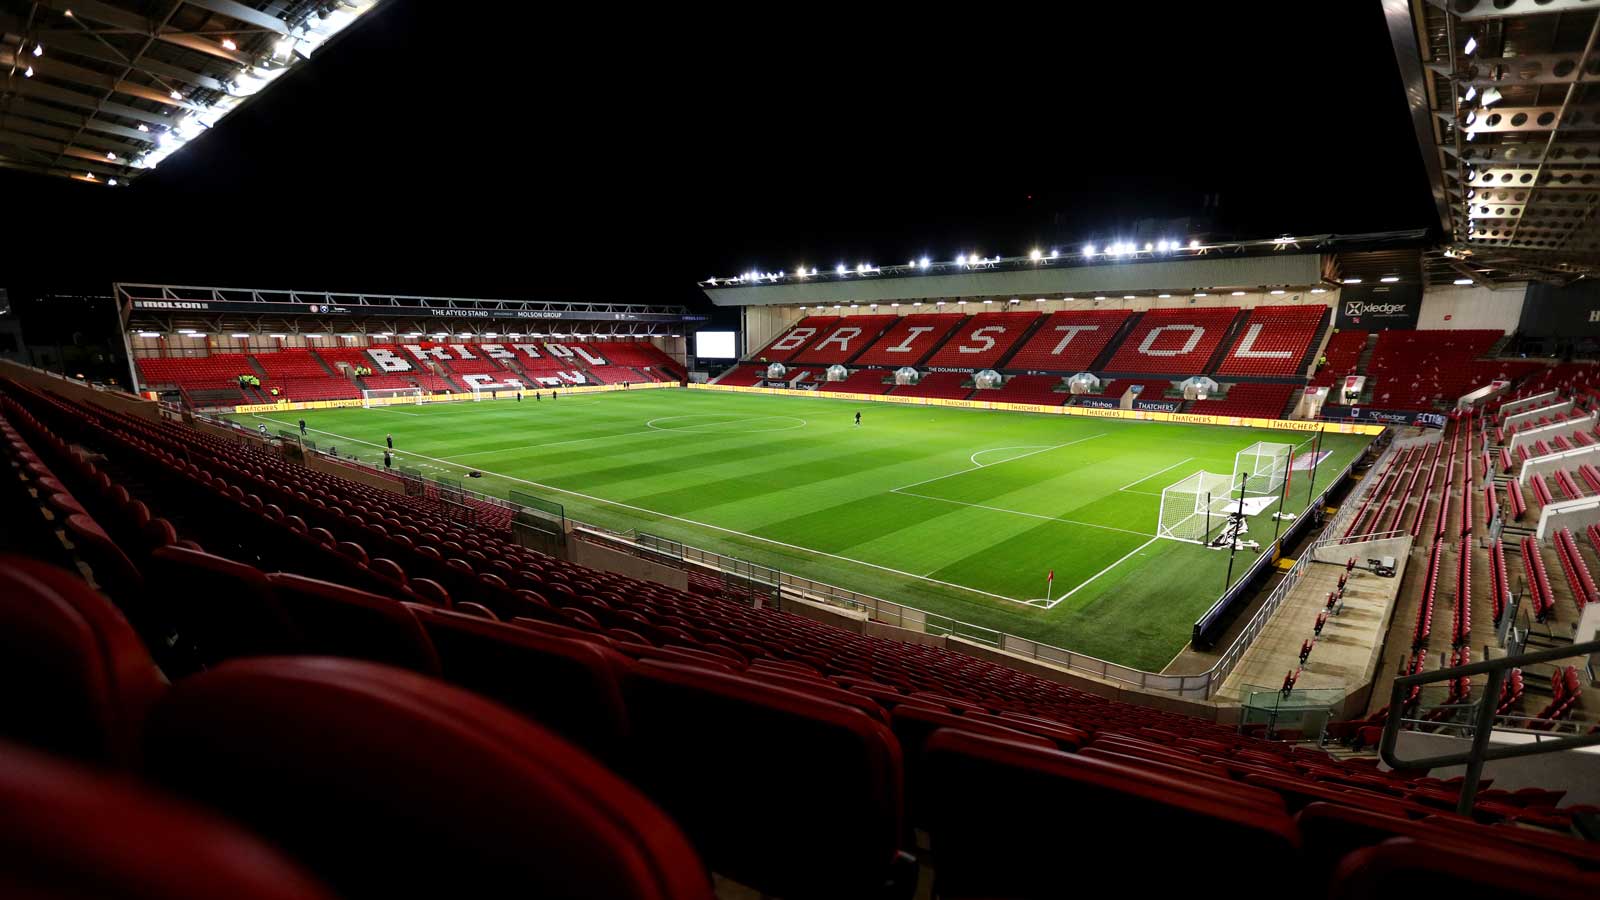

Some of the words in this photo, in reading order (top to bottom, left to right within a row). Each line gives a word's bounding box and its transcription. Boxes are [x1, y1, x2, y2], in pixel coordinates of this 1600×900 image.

[771, 323, 1292, 358] BRISTOL
[1138, 402, 1174, 411] THATCHERS
[1086, 409, 1120, 417] THATCHERS
[1171, 414, 1212, 424] THATCHERS
[1272, 420, 1319, 430] THATCHERS
